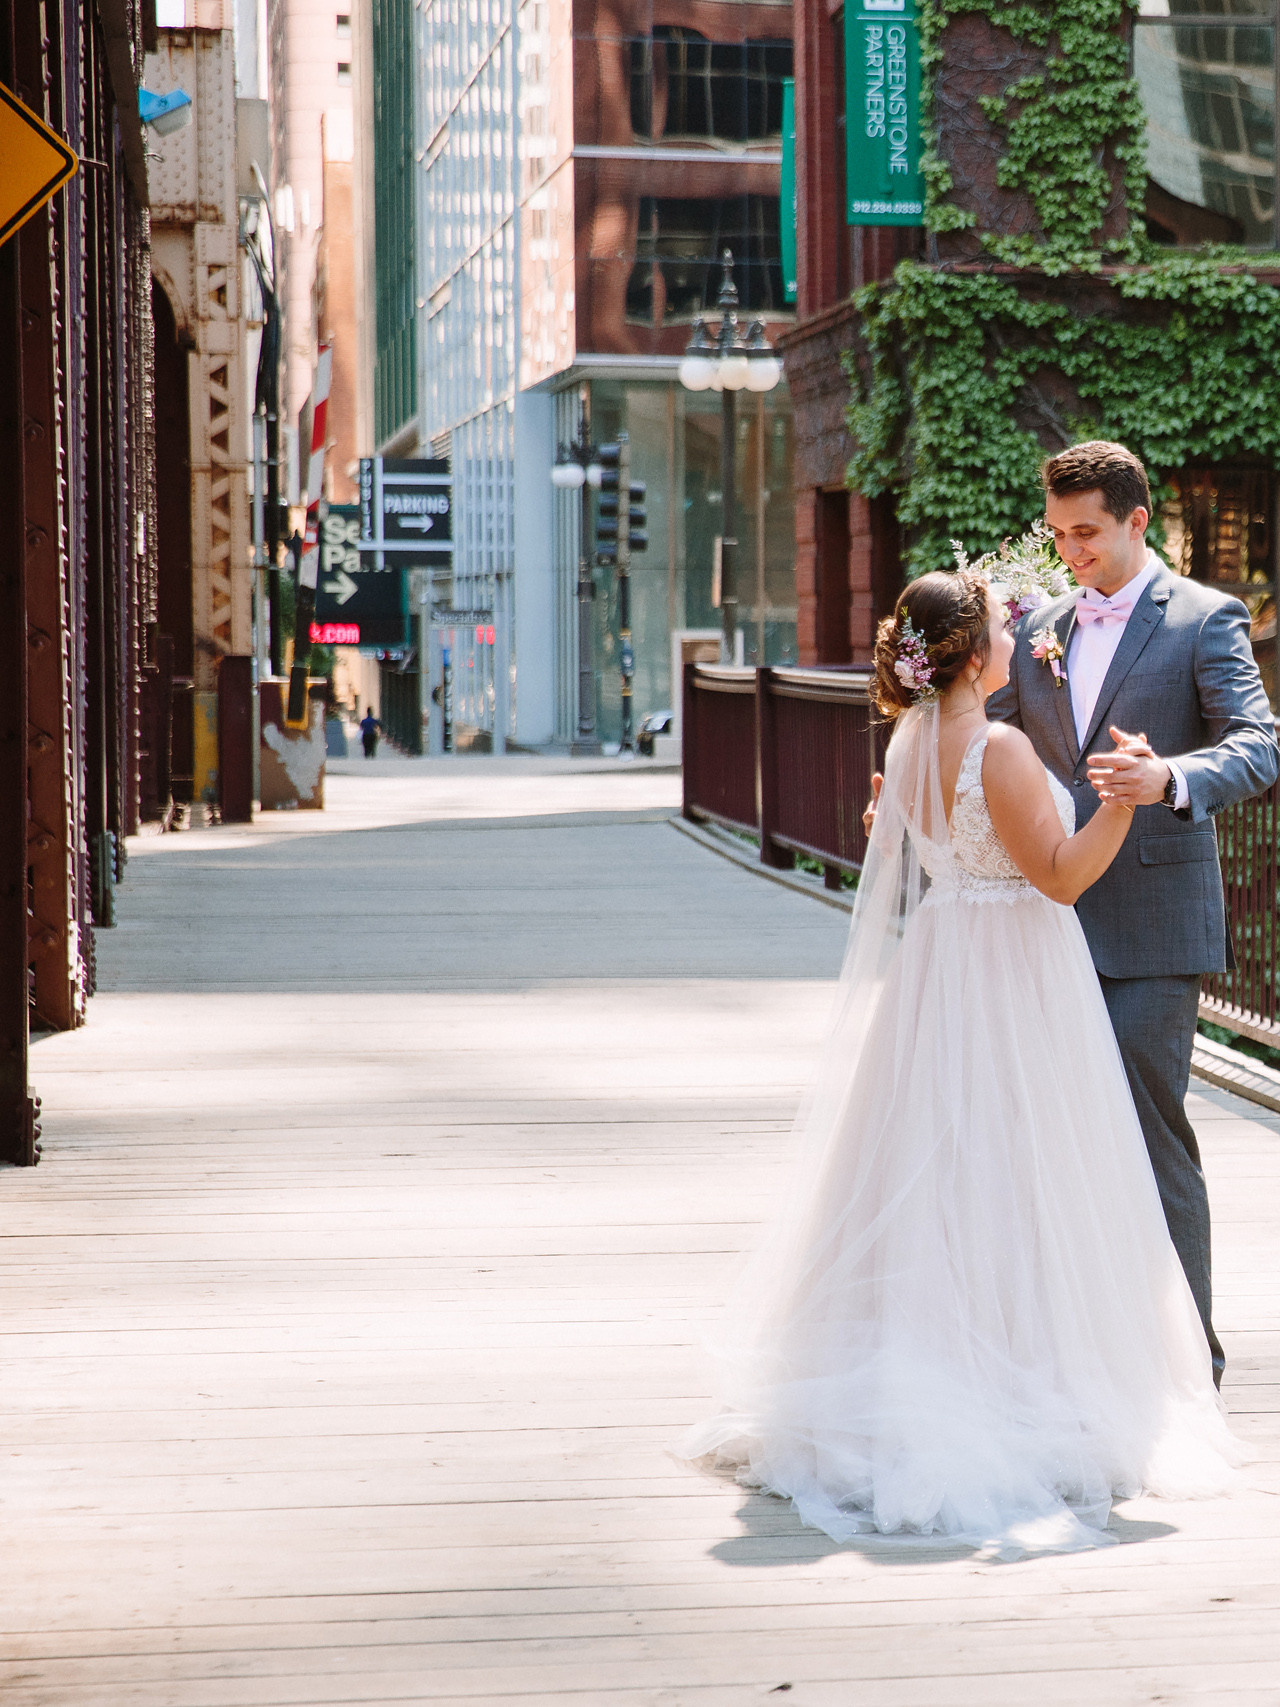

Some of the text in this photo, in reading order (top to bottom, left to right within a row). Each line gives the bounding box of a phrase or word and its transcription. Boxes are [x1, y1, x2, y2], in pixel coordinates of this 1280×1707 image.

[865, 24, 886, 138] PARTNERS
[886, 24, 909, 176] GREENSTONE
[323, 514, 361, 545] Se
[384, 493, 450, 514] PARKING
